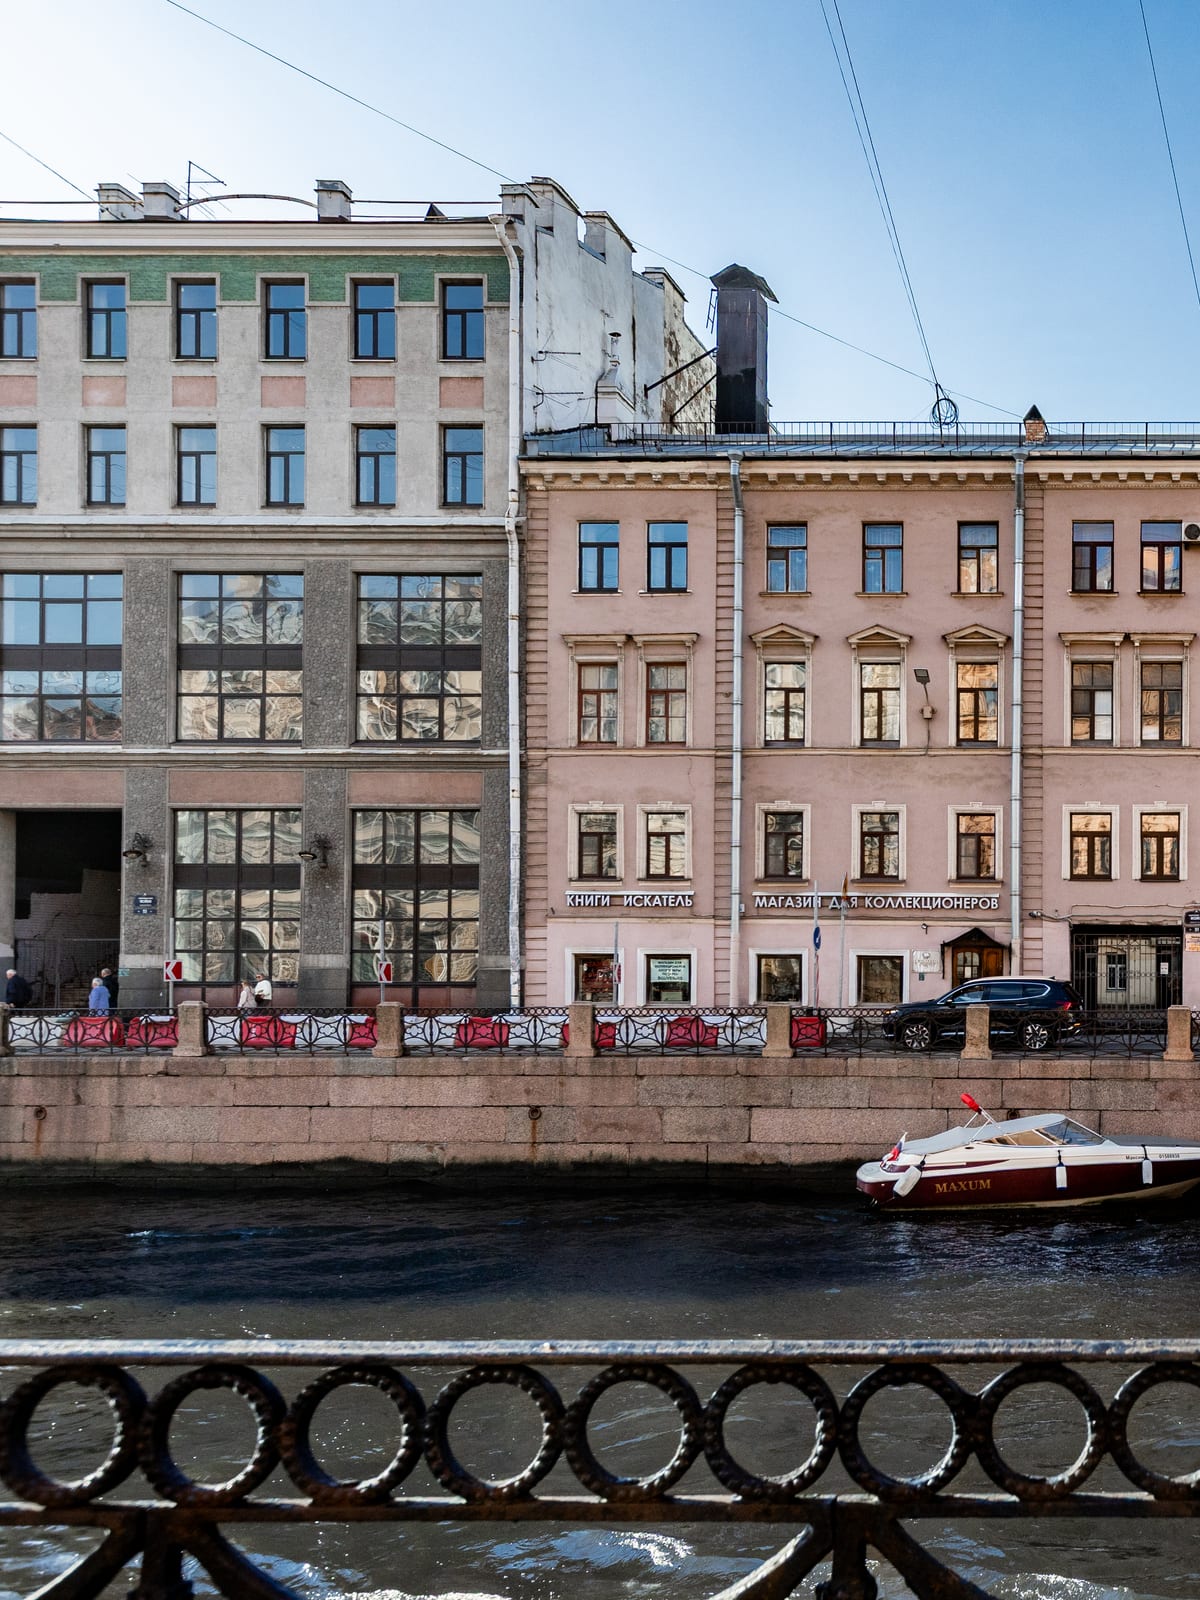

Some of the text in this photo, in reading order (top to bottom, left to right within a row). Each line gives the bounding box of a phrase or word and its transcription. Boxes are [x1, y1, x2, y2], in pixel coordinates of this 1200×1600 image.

[567, 895, 693, 907] КНИГИ ИСКАТЕЛЬ
[756, 896, 821, 908] МАГАЗИН
[865, 896, 998, 910] КОЛЛЕКЦИОНЕРОВ
[935, 1179, 991, 1193] MAXUM
